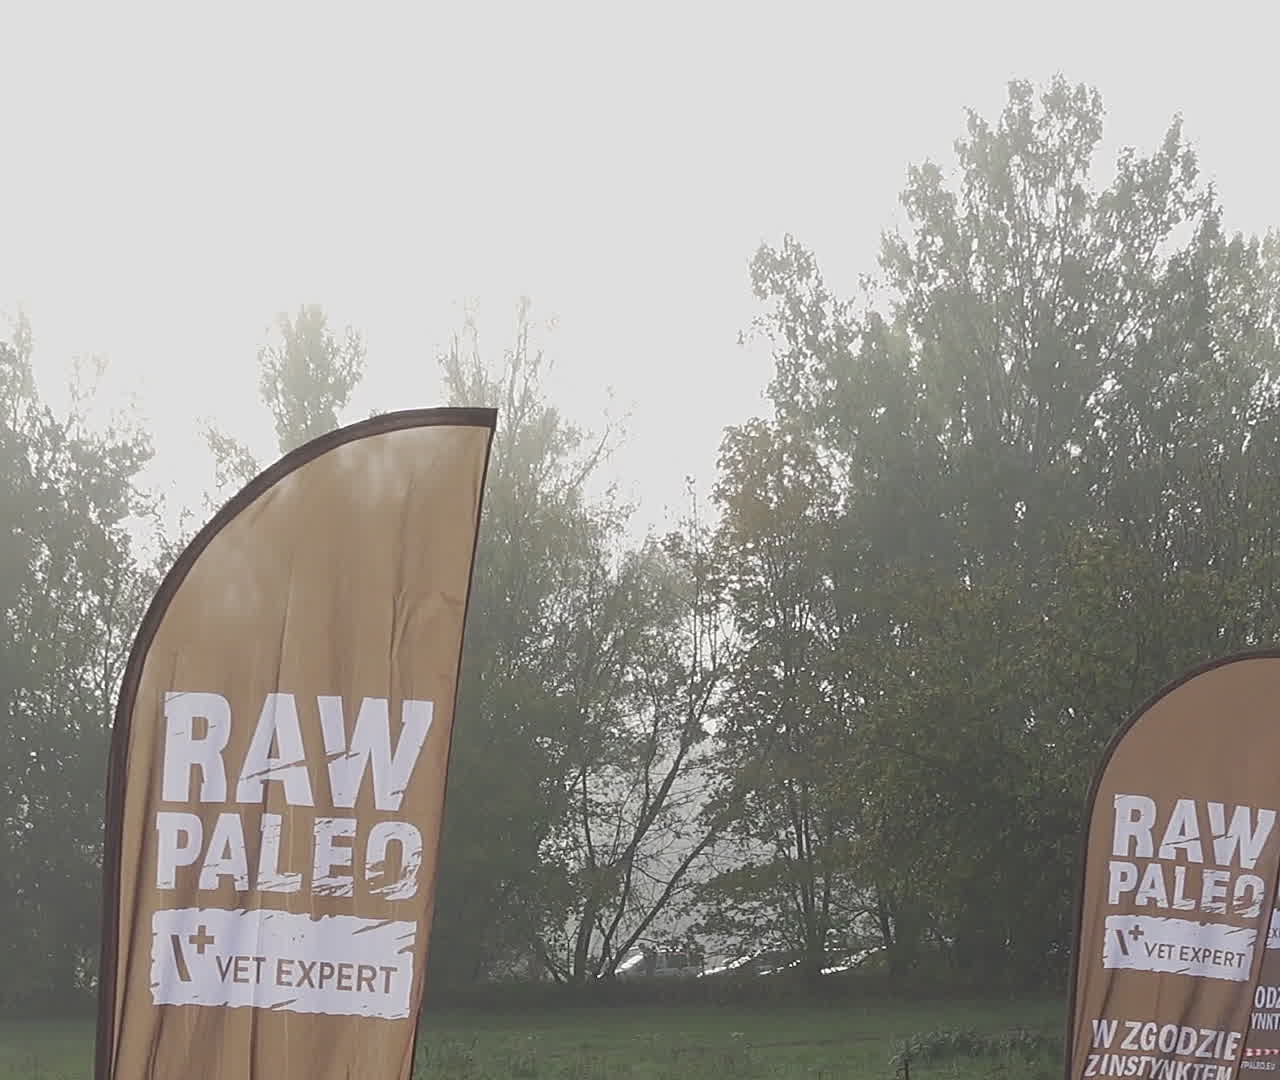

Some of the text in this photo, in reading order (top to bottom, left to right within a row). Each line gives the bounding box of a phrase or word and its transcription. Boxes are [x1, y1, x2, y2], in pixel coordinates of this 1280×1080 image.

[161, 690, 434, 812] RAW
[154, 810, 424, 901] PALEO
[1111, 793, 1278, 870] RAW
[1107, 860, 1266, 919] PALEO
[216, 954, 399, 995] VET EXPERT
[1144, 942, 1247, 969] VET EXPERT
[1084, 1053, 1101, 1078] Z
[1091, 1018, 1242, 1062] W ZGODZIE
